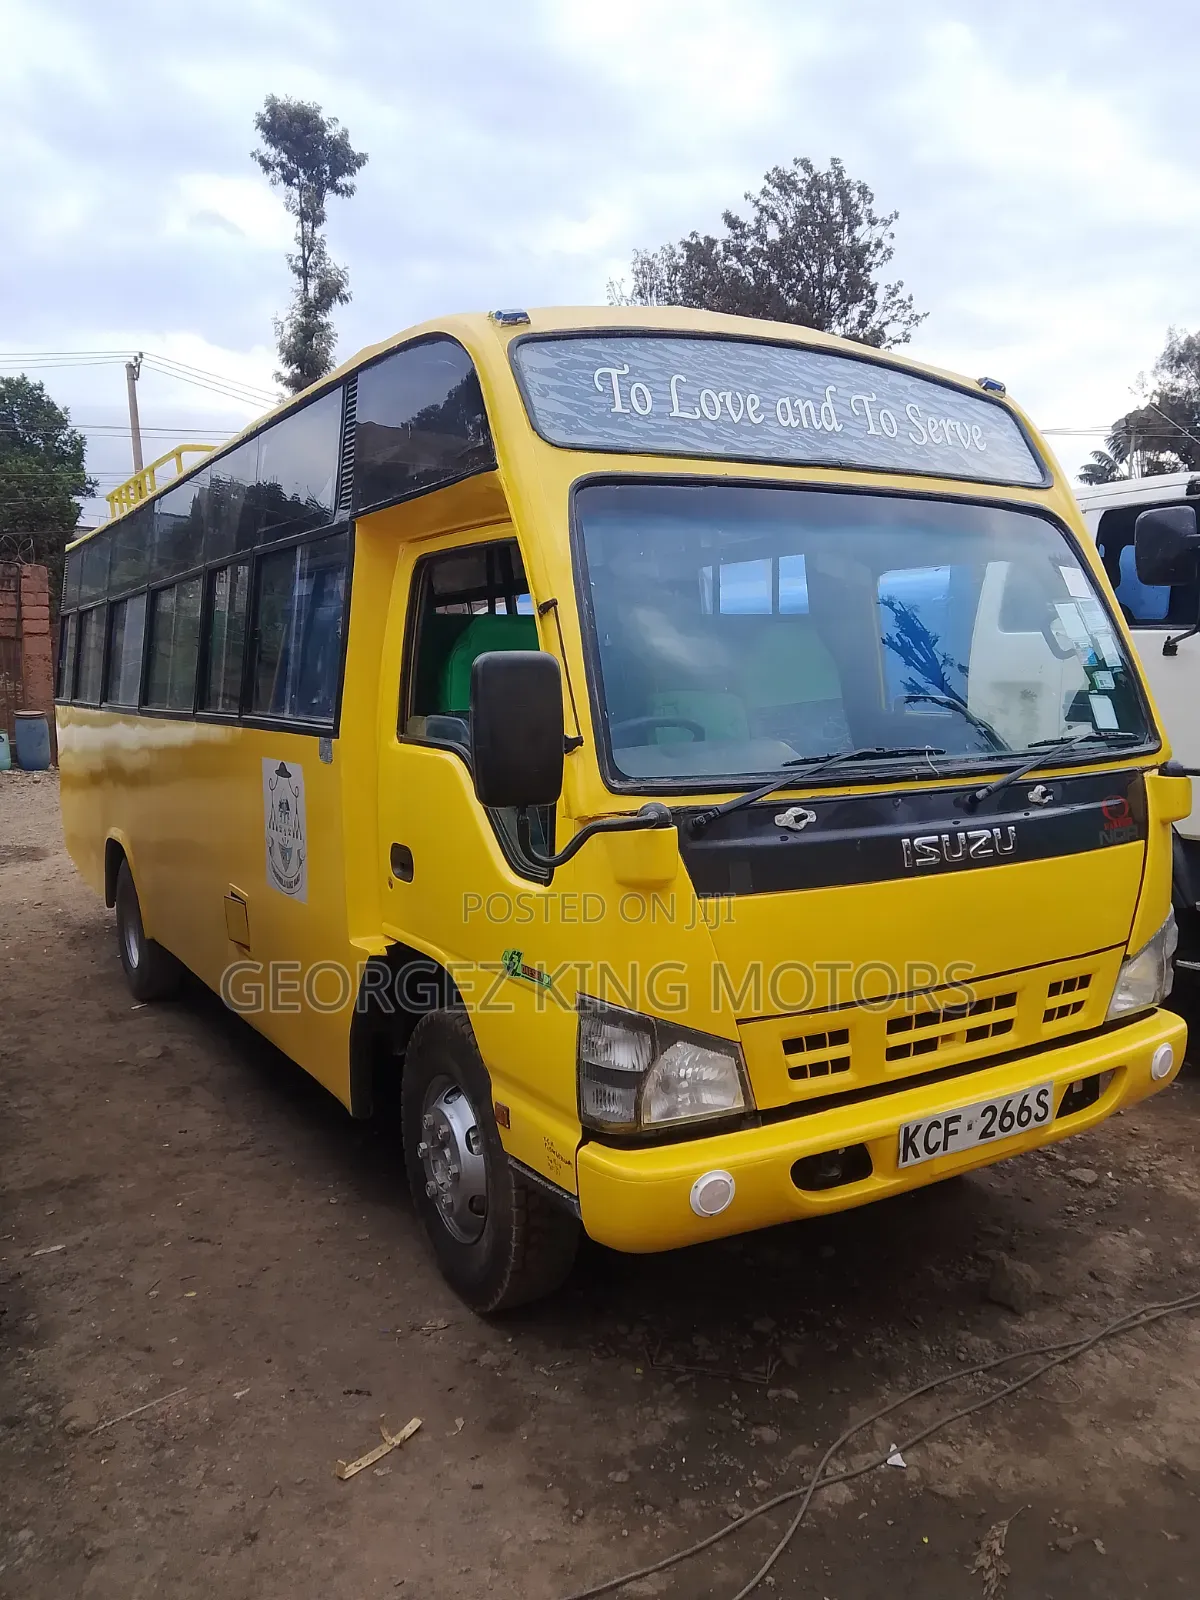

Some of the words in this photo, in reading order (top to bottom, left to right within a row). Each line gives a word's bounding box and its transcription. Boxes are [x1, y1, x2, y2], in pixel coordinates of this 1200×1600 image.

[593, 364, 653, 416] To
[668, 374, 764, 426] Love
[776, 385, 843, 433] and
[851, 392, 899, 438] To
[907, 403, 987, 451] Serve
[901, 826, 1018, 868] ISUZU
[901, 1114, 962, 1164] KCF
[978, 1088, 1050, 1140] 266S
